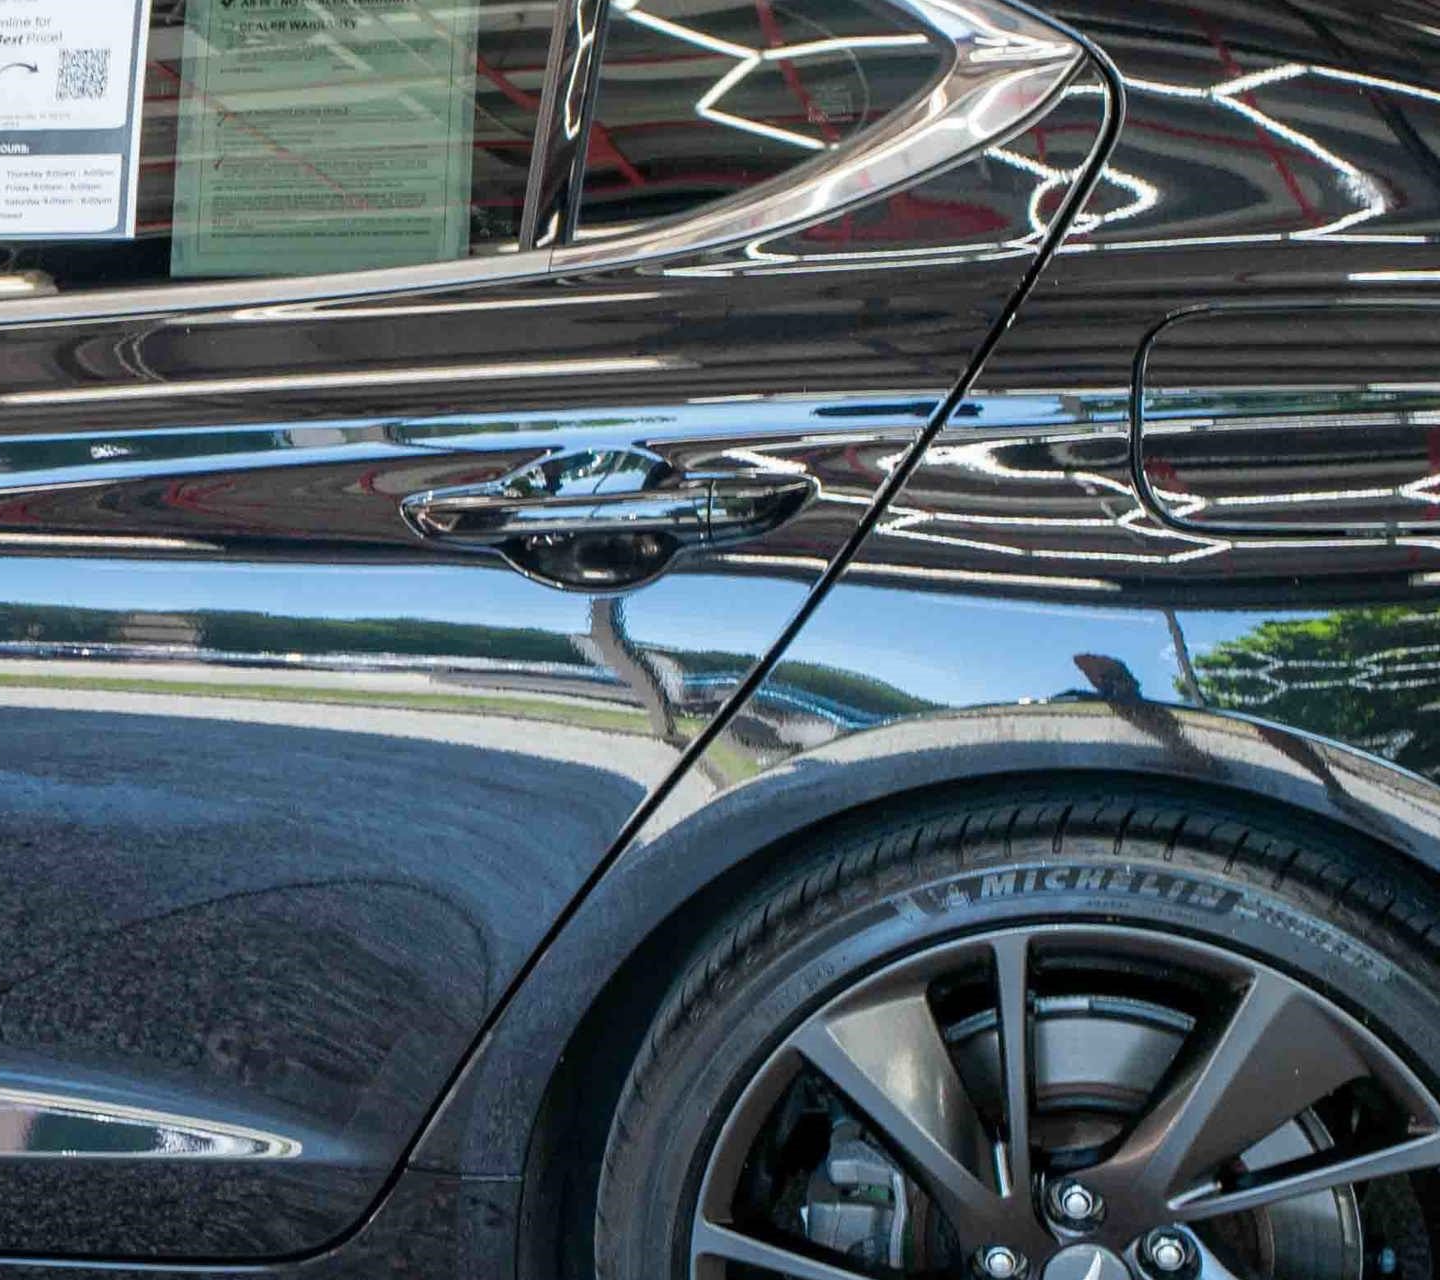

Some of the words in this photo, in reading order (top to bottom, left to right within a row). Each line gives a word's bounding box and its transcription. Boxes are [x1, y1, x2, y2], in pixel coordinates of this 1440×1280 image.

[35, 15, 53, 27] for
[239, 21, 287, 33] DEALER
[980, 867, 1228, 908] MICHELIN
